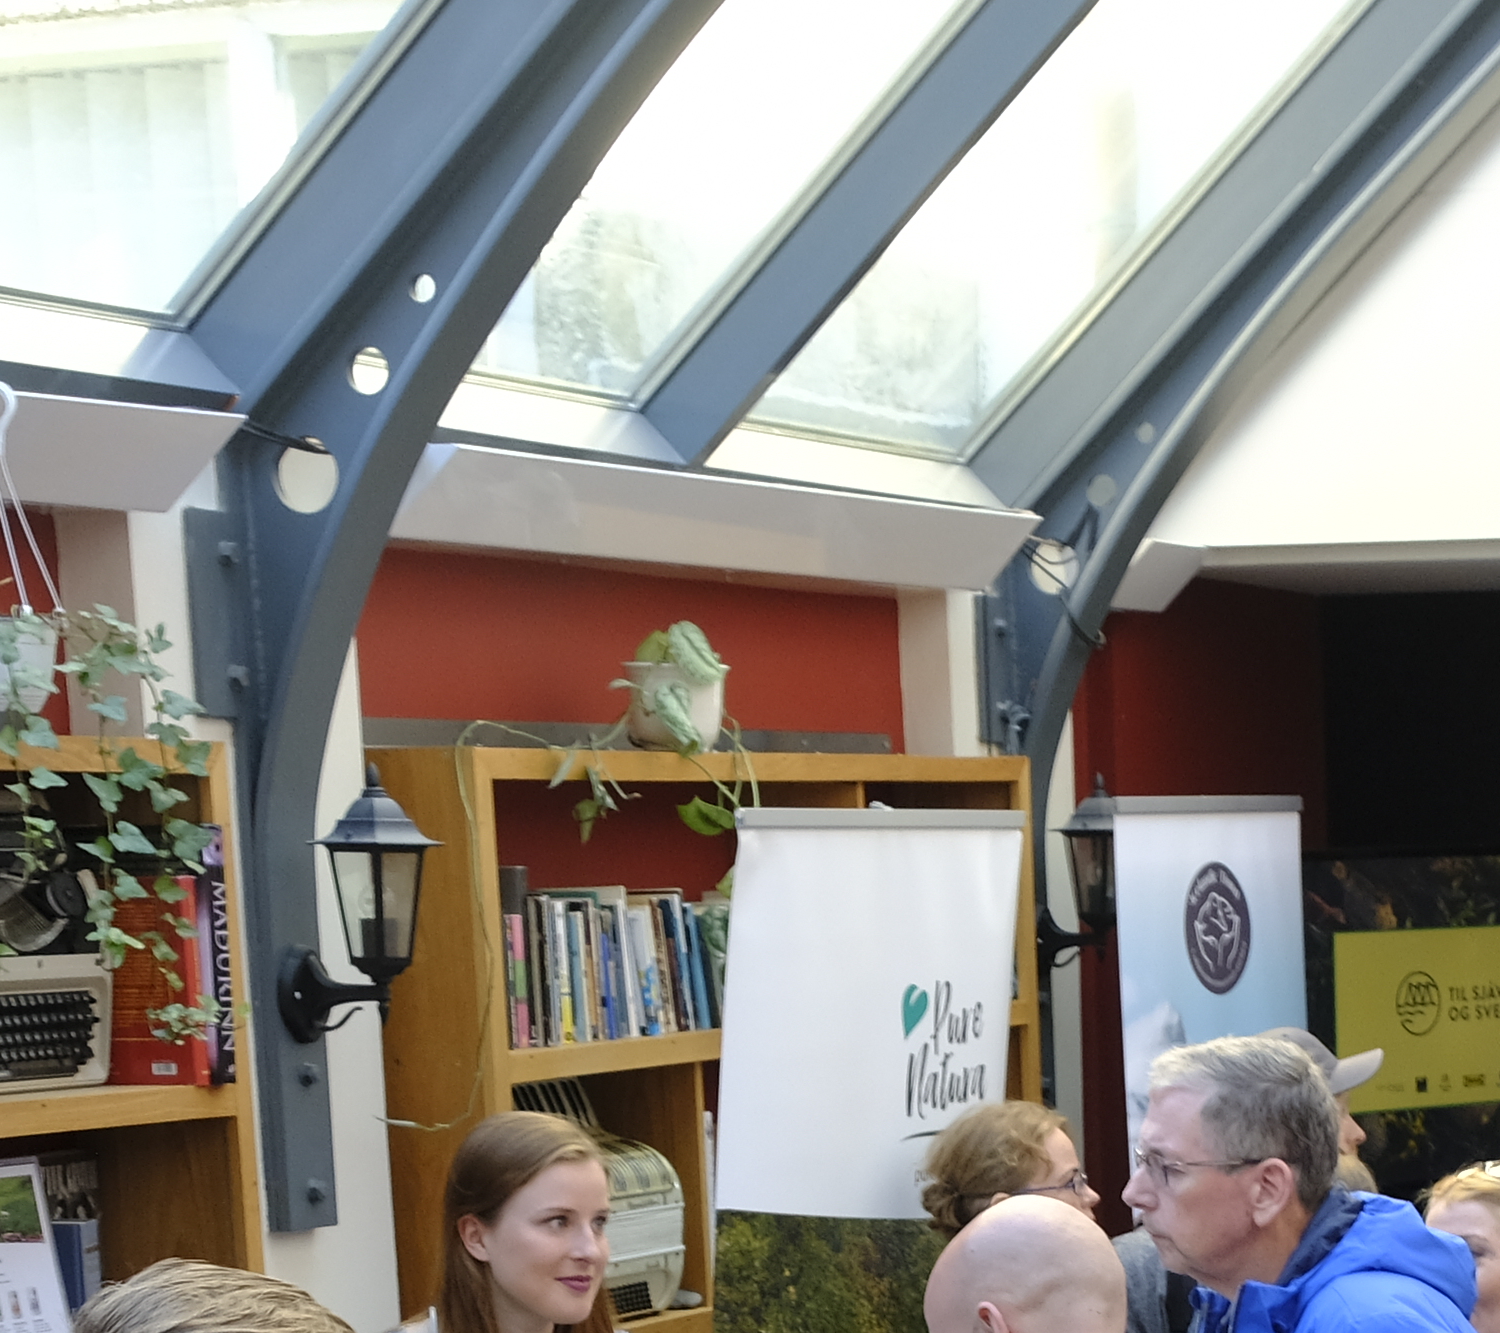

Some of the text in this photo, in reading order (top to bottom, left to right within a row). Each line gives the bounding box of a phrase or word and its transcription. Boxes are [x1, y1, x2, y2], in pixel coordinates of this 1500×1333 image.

[1447, 1005, 1470, 1022] OG
[1448, 985, 1468, 1002] TIL
[930, 979, 985, 1056] Pure
[904, 1042, 987, 1121] Natura
